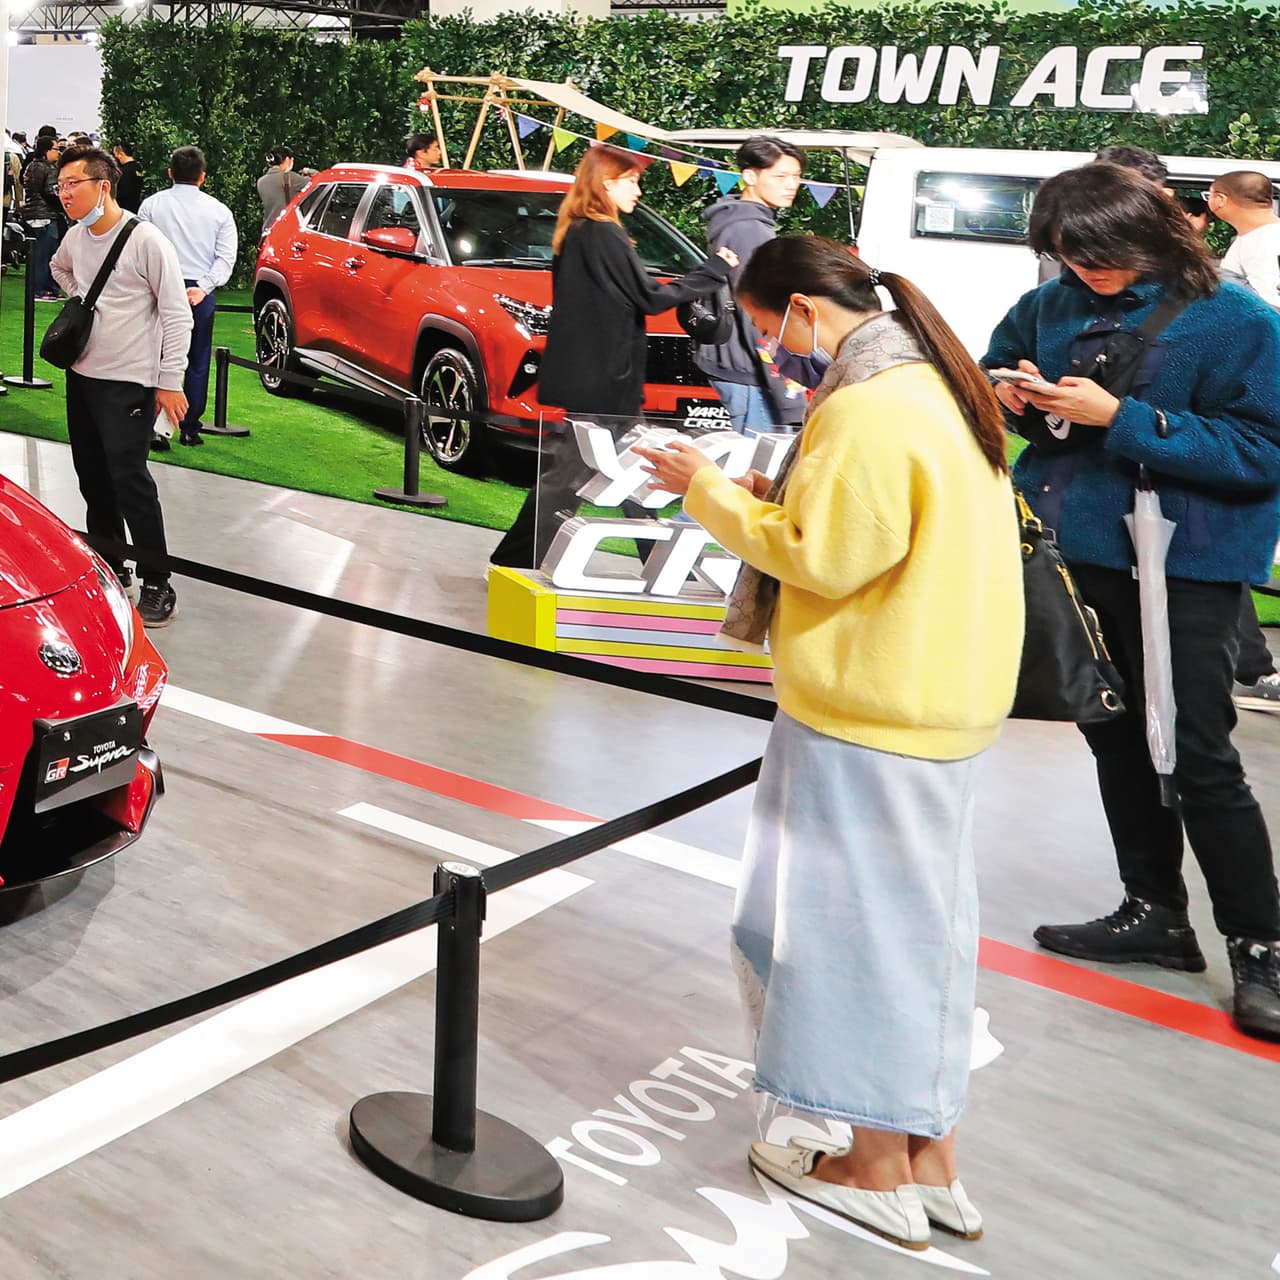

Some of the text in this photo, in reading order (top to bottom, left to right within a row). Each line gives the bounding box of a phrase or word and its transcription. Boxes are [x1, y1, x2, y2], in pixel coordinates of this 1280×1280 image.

[777, 45, 1205, 113] TOWN ACE
[69, 745, 136, 774] Supra
[93, 740, 116, 754] TOYOTA
[546, 1045, 758, 1187] TOYOTA
